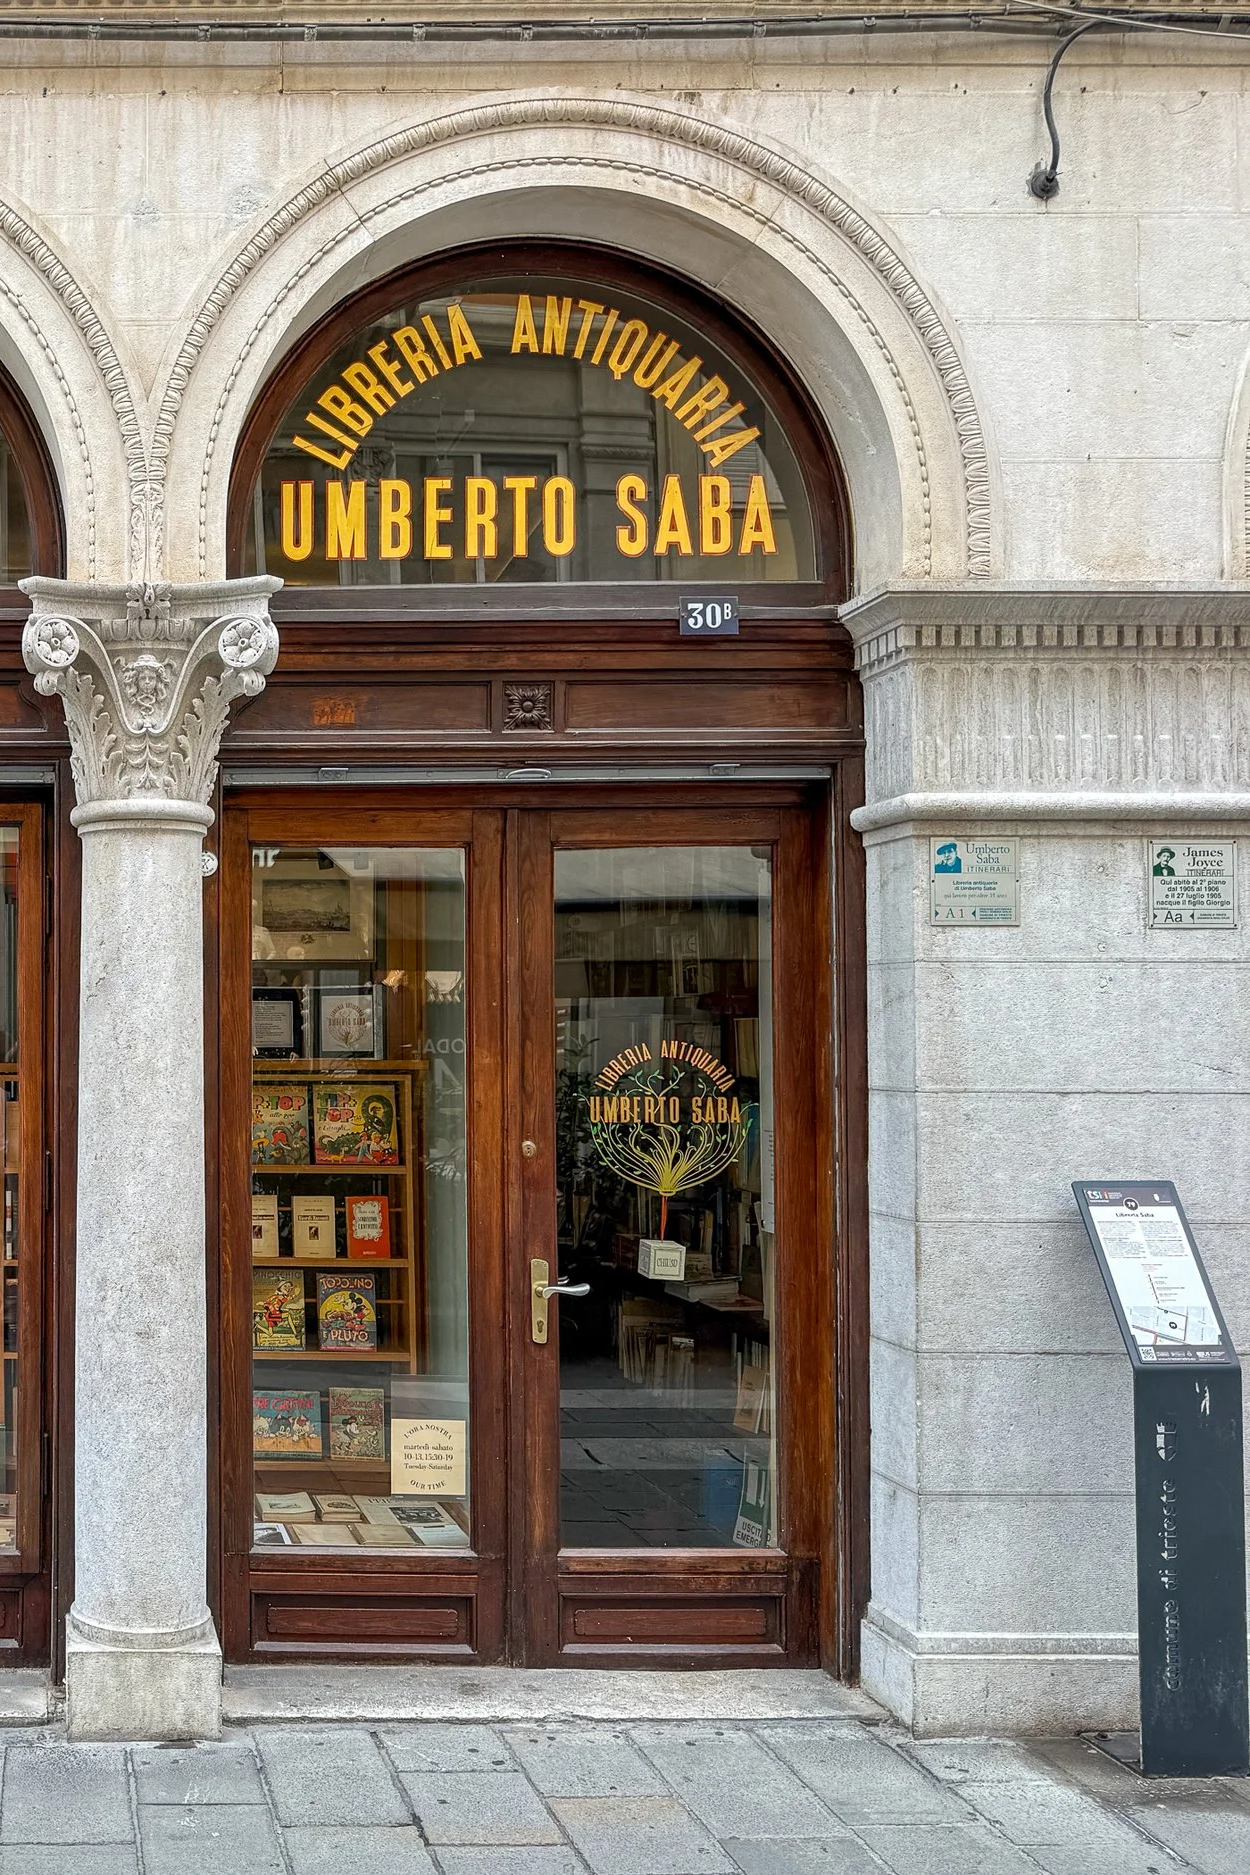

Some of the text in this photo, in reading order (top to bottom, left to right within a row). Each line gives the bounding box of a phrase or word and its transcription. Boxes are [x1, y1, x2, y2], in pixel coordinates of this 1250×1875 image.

[293, 294, 762, 471] LIBRERIA ANTIQUARIA
[280, 474, 778, 562] UMBERTO SABA
[966, 843, 1010, 854] Umberto
[1183, 847, 1224, 857] James
[976, 854, 1000, 864] Saba
[1188, 857, 1224, 870] Joyce
[1208, 879, 1226, 887] piano
[1164, 911, 1183, 923] Aa
[595, 1040, 736, 1093] LIBRERIA ANTIQUARIA
[269, 1095, 306, 1111] TOP
[317, 1092, 351, 1108] TIP
[317, 1107, 354, 1122] TOP
[589, 1096, 741, 1124] UMBERTO SABA
[656, 1258, 678, 1267] CHIUSO
[253, 1270, 302, 1279] PINOCCHIO
[319, 1277, 373, 1289] TOPOLINO
[330, 1329, 369, 1341] PLUTO
[272, 1398, 314, 1411] GATTINI
[404, 1424, 452, 1440] L'ORA NOSTRA
[410, 1479, 447, 1490] OUR TIME
[741, 1521, 763, 1537] USCIT
[736, 1530, 761, 1548] EMERG
[1158, 1479, 1182, 1692] comune di trieste
